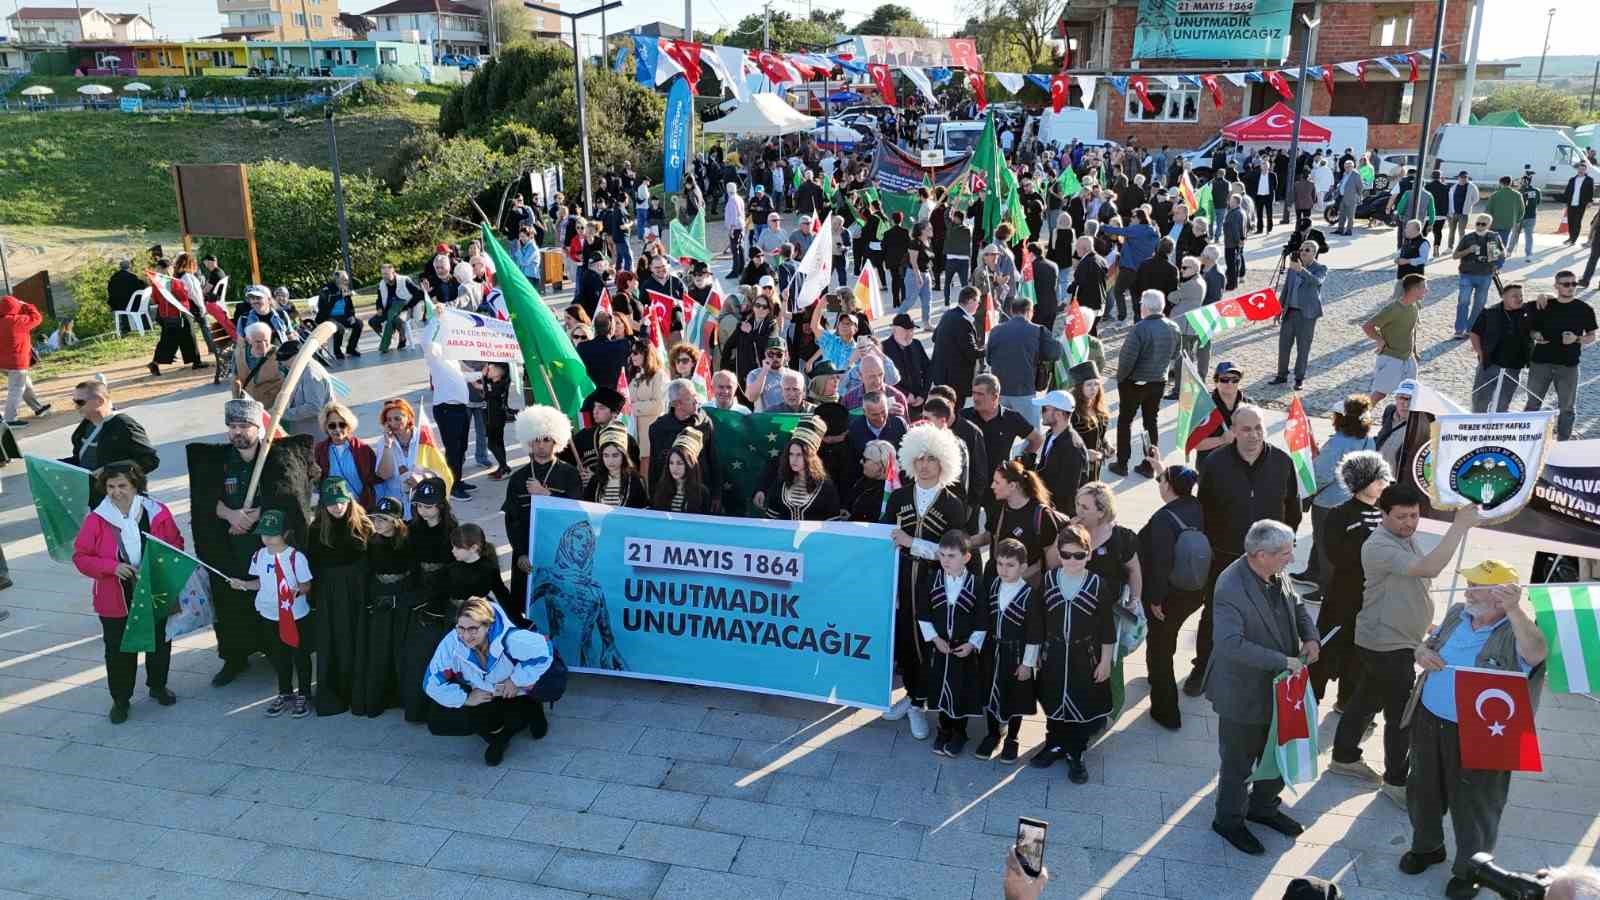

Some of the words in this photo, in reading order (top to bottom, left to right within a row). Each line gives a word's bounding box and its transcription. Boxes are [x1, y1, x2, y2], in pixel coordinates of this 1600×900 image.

[1177, 2, 1193, 10] 21
[1194, 2, 1225, 10] MAYIS
[1228, 1, 1254, 10] 1864
[1173, 26, 1282, 40] UNUTMAYACAĞIZ
[1174, 16, 1251, 28] UNUTMADIK
[627, 543, 652, 563] 21
[663, 546, 733, 571] MAYIS
[743, 553, 799, 577] 1864
[624, 578, 799, 619] UNUTMADIK
[623, 607, 872, 660] UNUTMAYACAĞIZ
